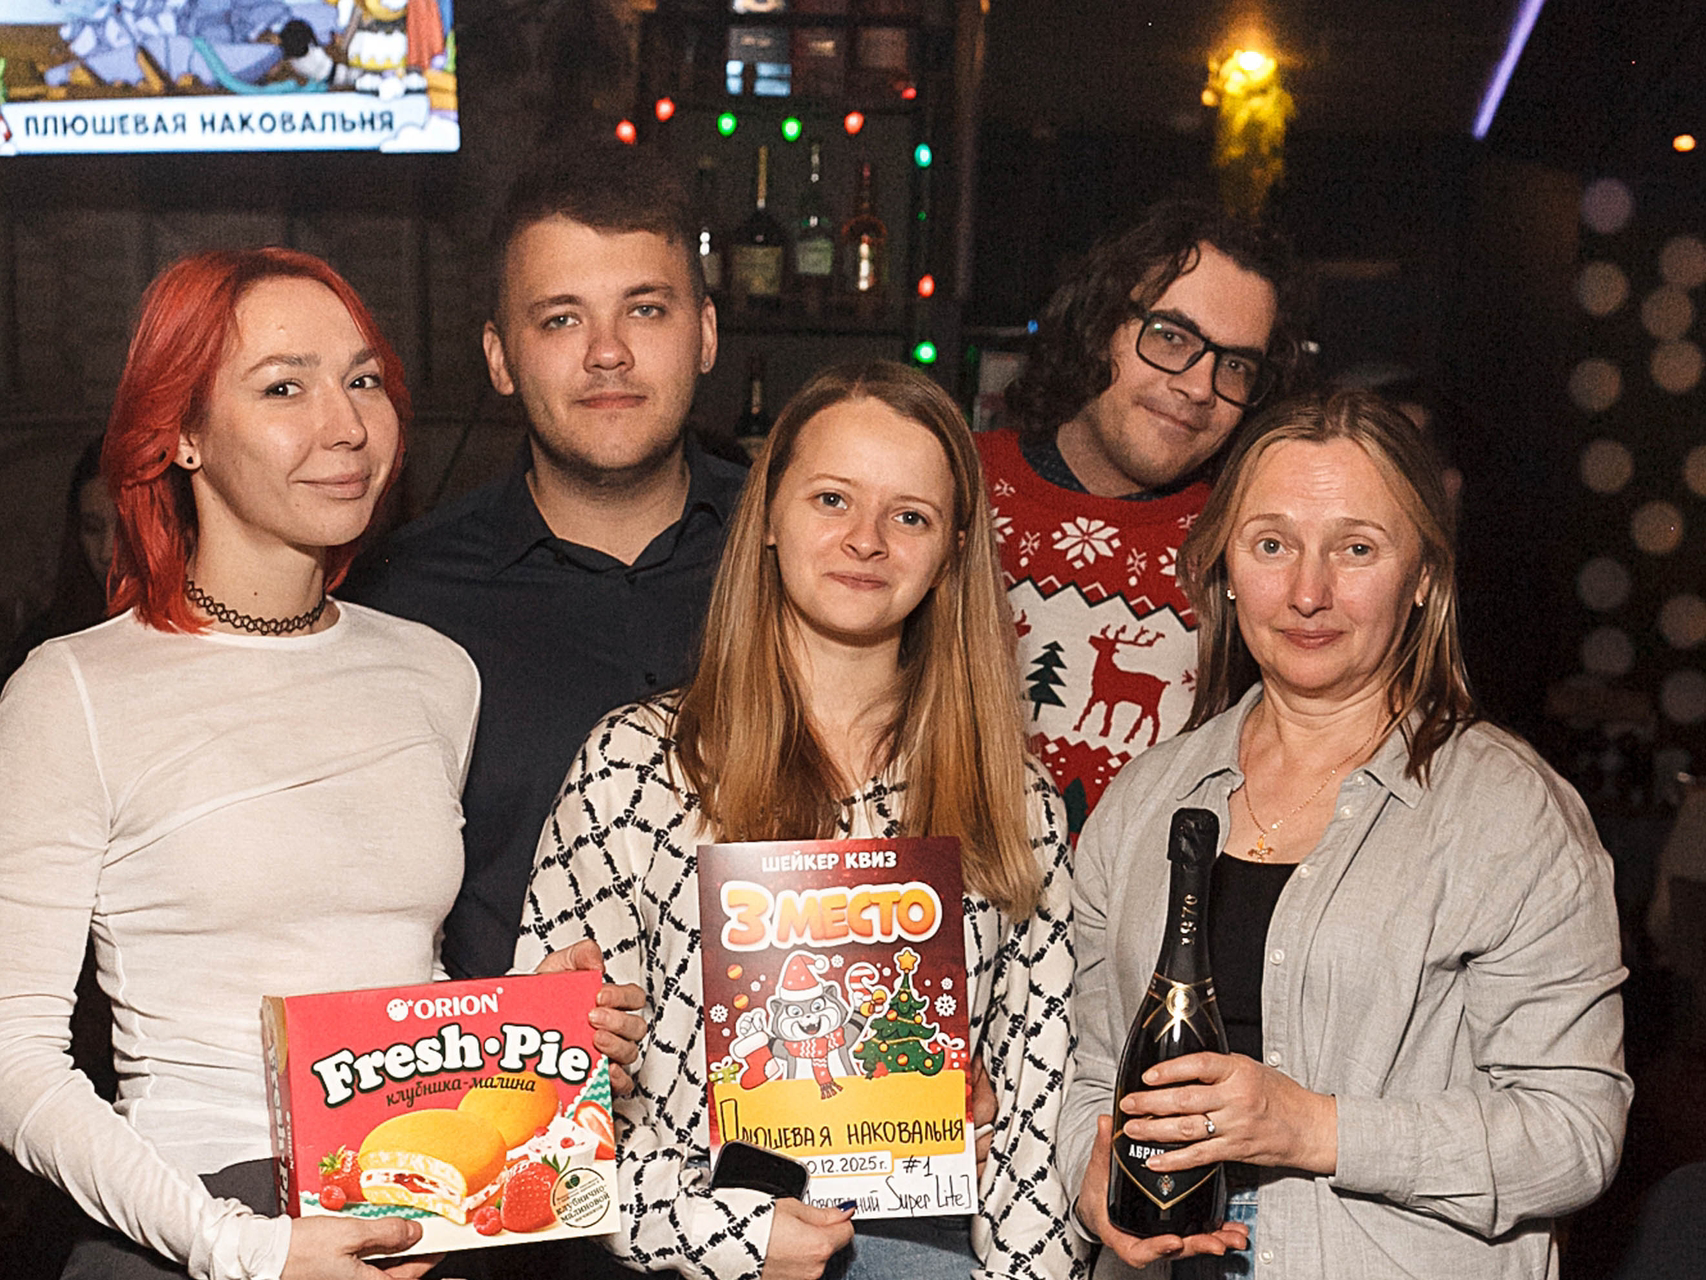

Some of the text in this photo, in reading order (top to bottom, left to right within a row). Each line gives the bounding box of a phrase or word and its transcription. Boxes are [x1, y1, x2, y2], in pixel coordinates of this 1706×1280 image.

[25, 111, 394, 137] ПЛЮШЕВАЯ НАКОВАЛЬНЯ
[761, 850, 897, 873] ШЕЙКЕР КВИЗ
[724, 885, 939, 948] 3 МЕСТО
[413, 993, 499, 1020] ORION
[386, 1076, 536, 1108] клубника-малина
[846, 1117, 964, 1146] НАКОВАЛЬНЯ
[806, 1155, 933, 1177] 0.12.2025г. #1
[885, 1175, 931, 1217] Super
